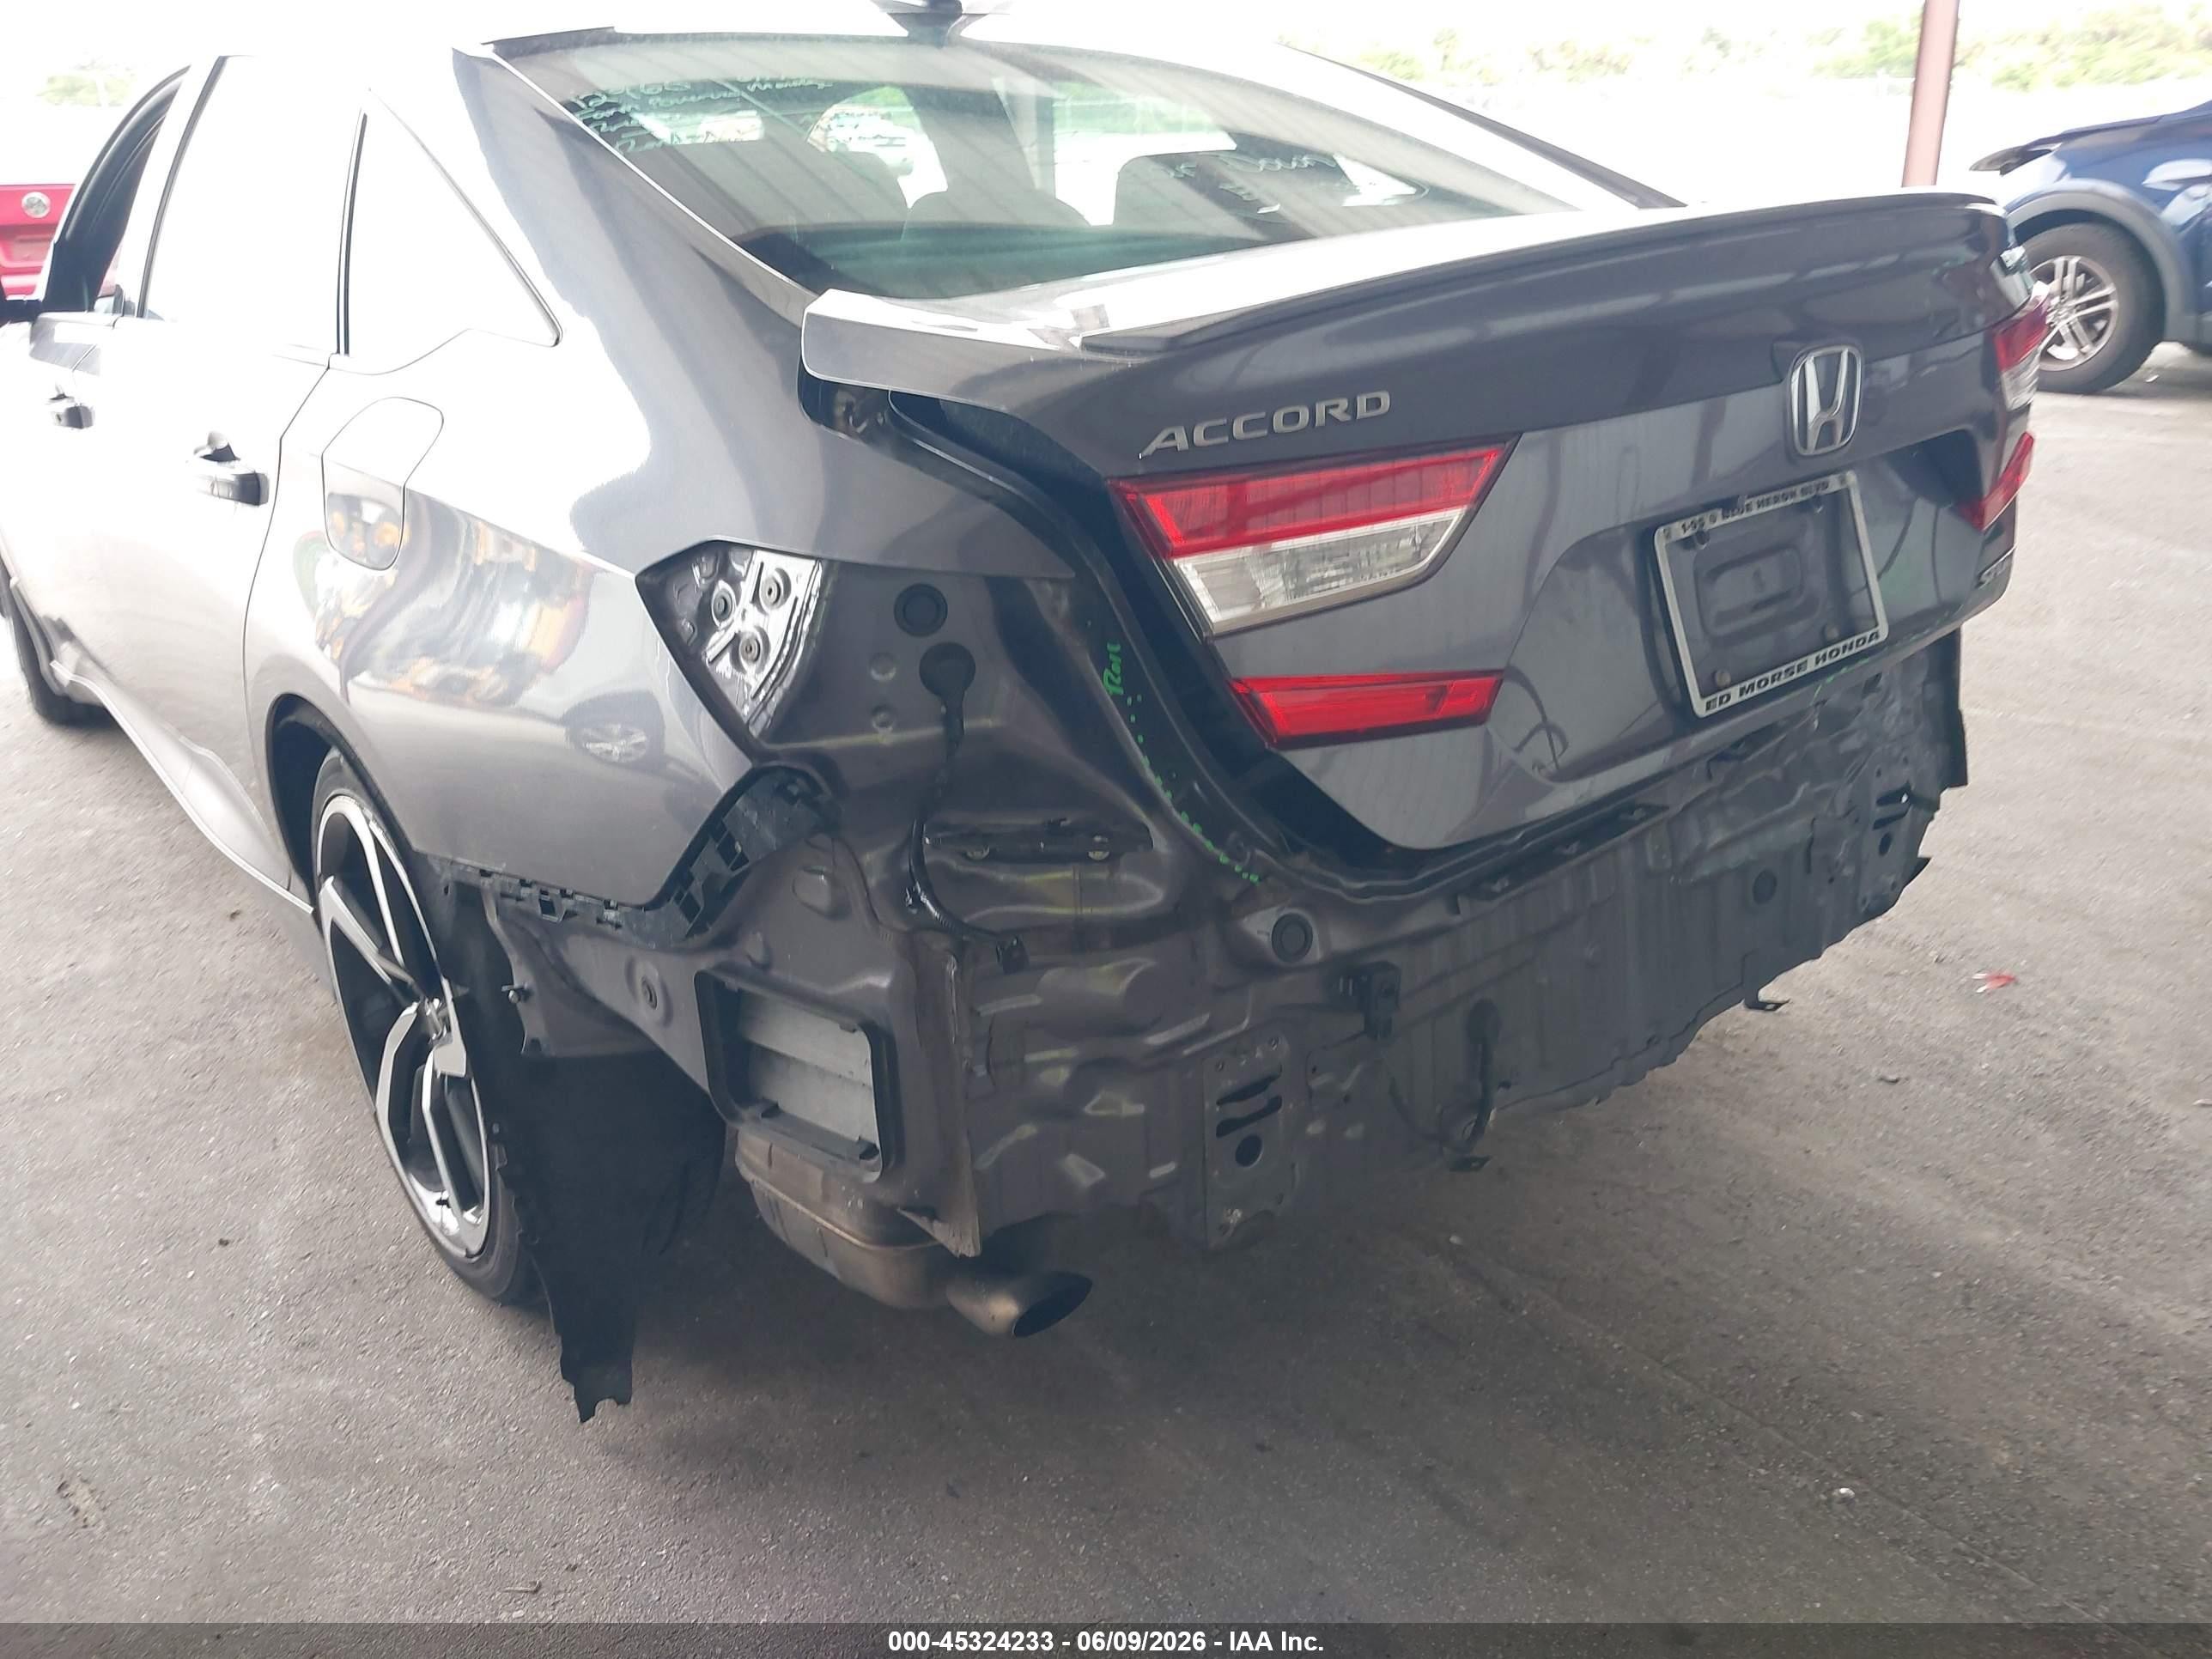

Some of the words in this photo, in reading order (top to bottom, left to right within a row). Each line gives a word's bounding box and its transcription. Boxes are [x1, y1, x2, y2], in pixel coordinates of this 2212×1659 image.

[1138, 390, 1391, 459] ACCORD
[1705, 693, 1731, 712] ED
[1739, 659, 1808, 698] MORSE
[1814, 630, 1881, 665] HONDA
